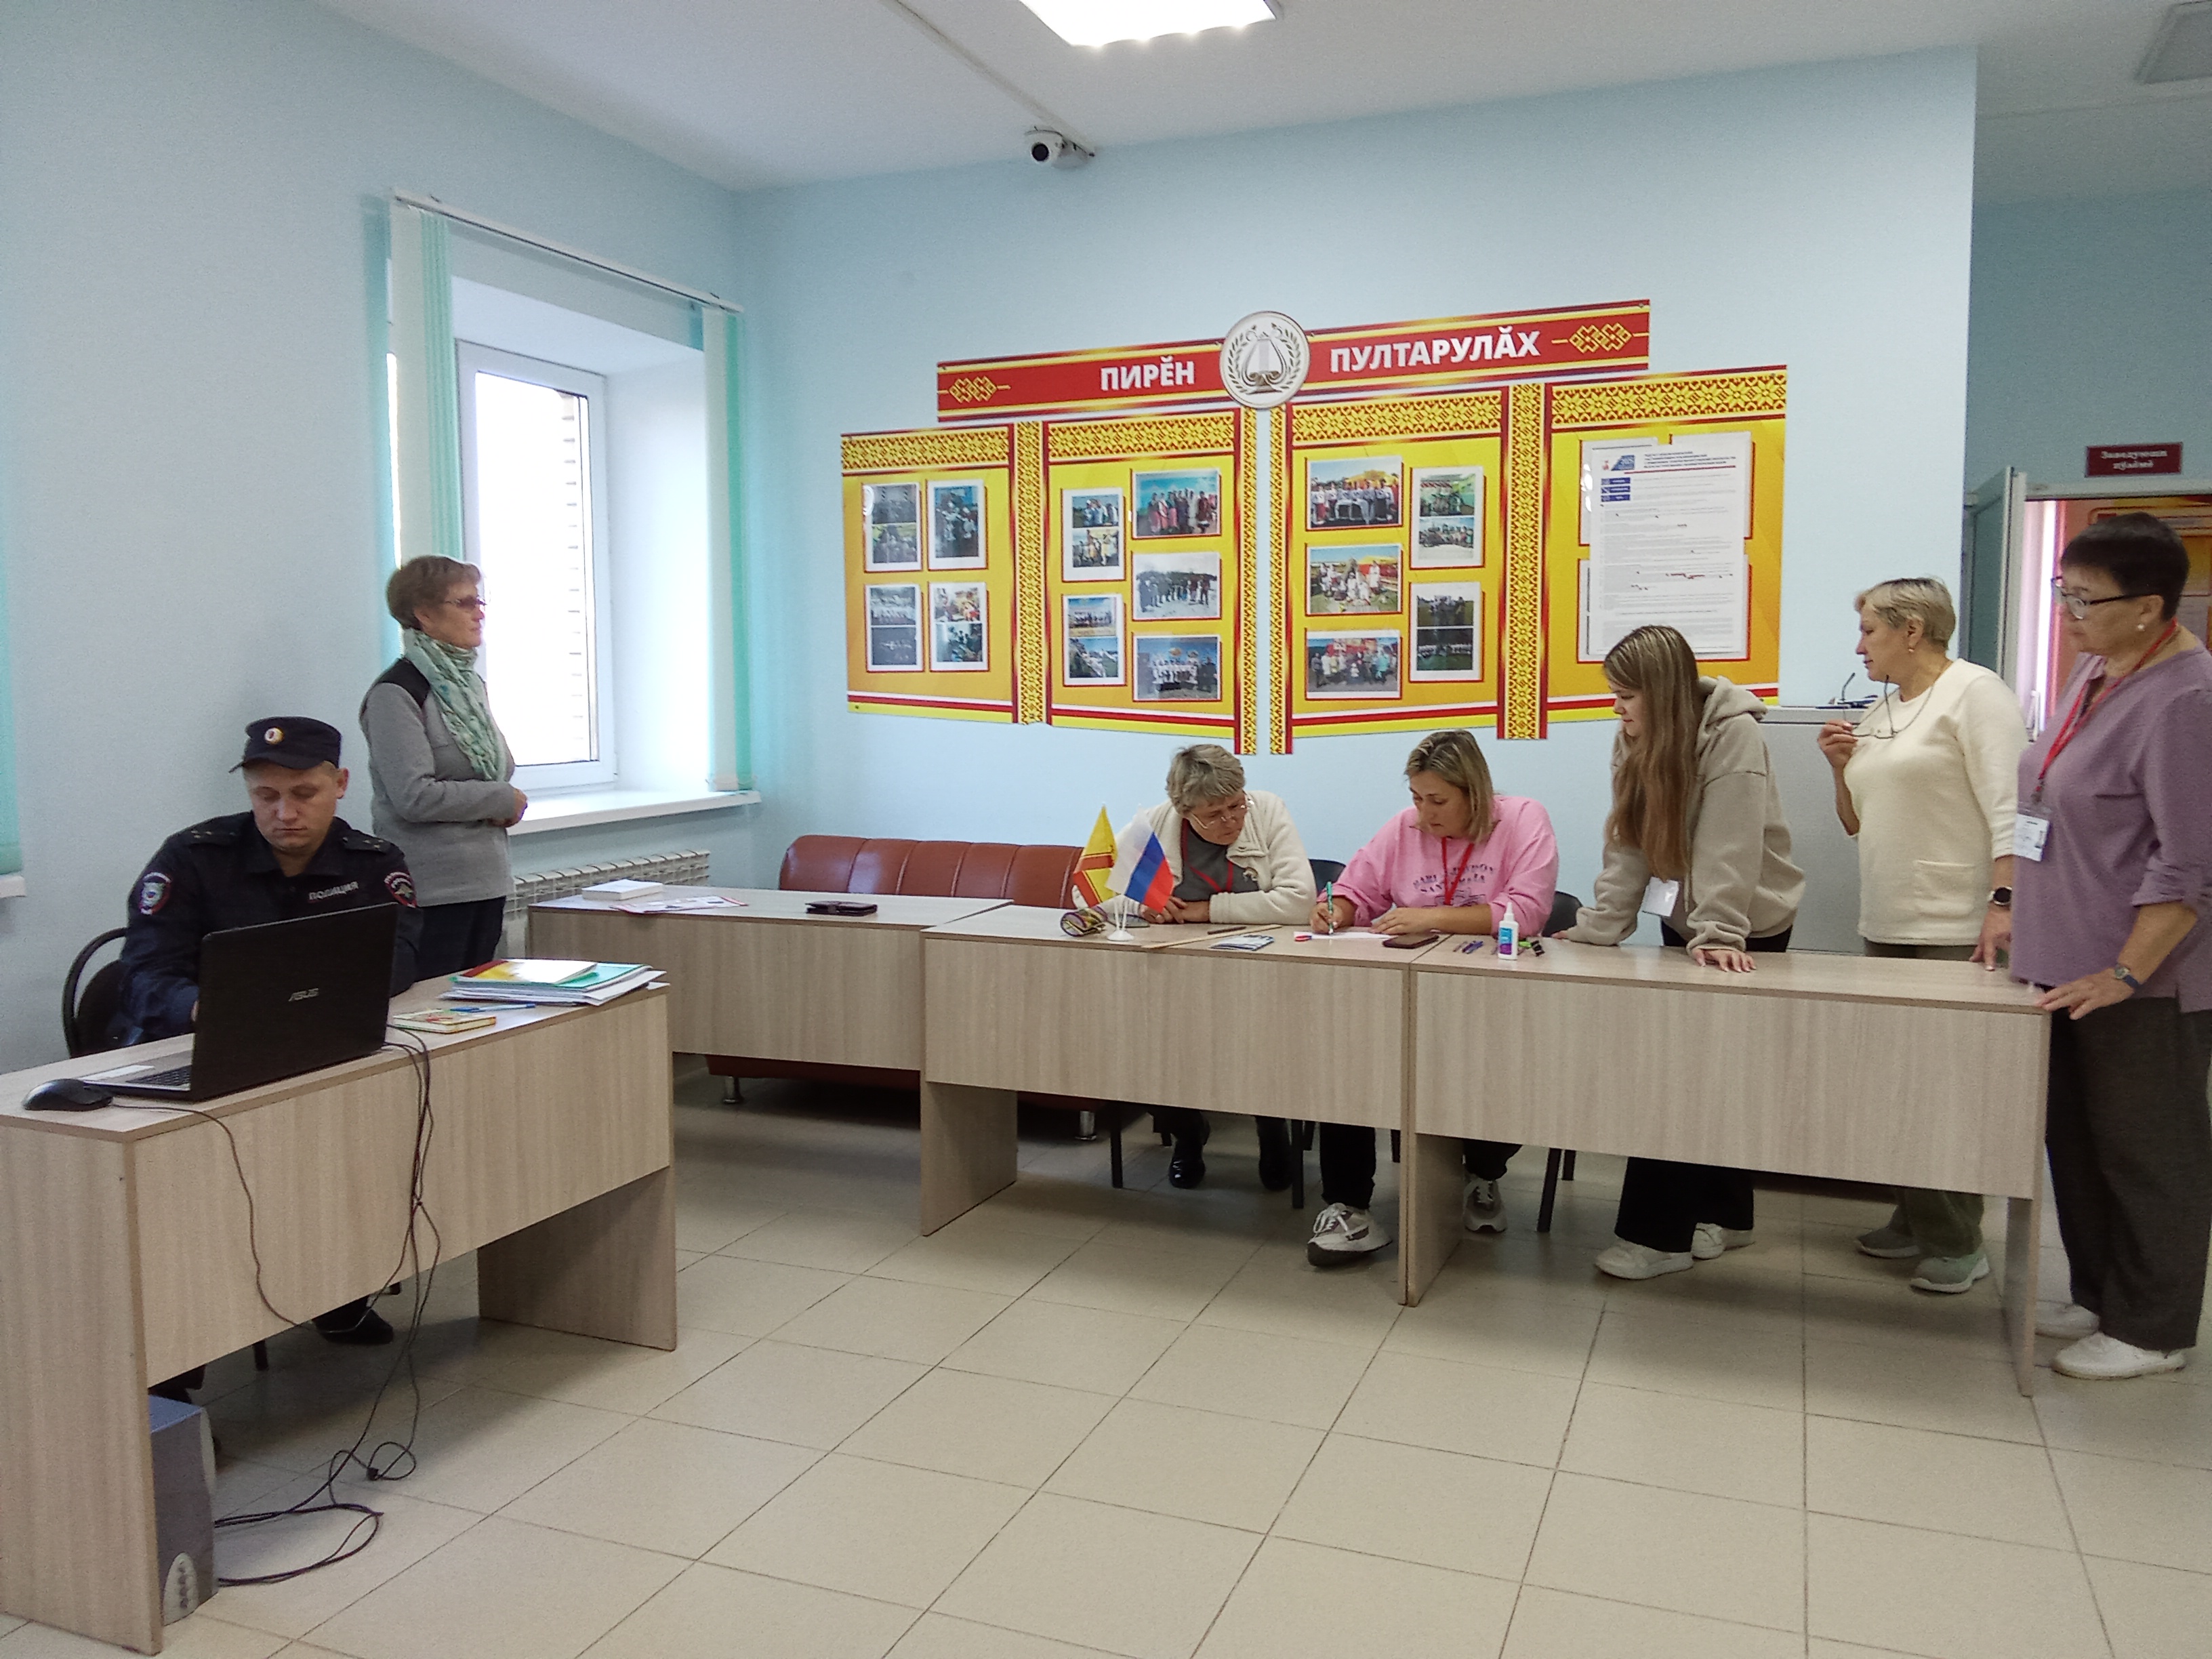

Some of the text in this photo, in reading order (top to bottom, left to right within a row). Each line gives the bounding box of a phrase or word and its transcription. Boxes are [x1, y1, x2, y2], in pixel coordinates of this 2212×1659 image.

[1101, 325, 1540, 391] ПИРӖН ПУЛТАРУЛӐХ
[309, 881, 359, 900] ПОЛИЦИЯ
[288, 987, 319, 1002] ASUS
